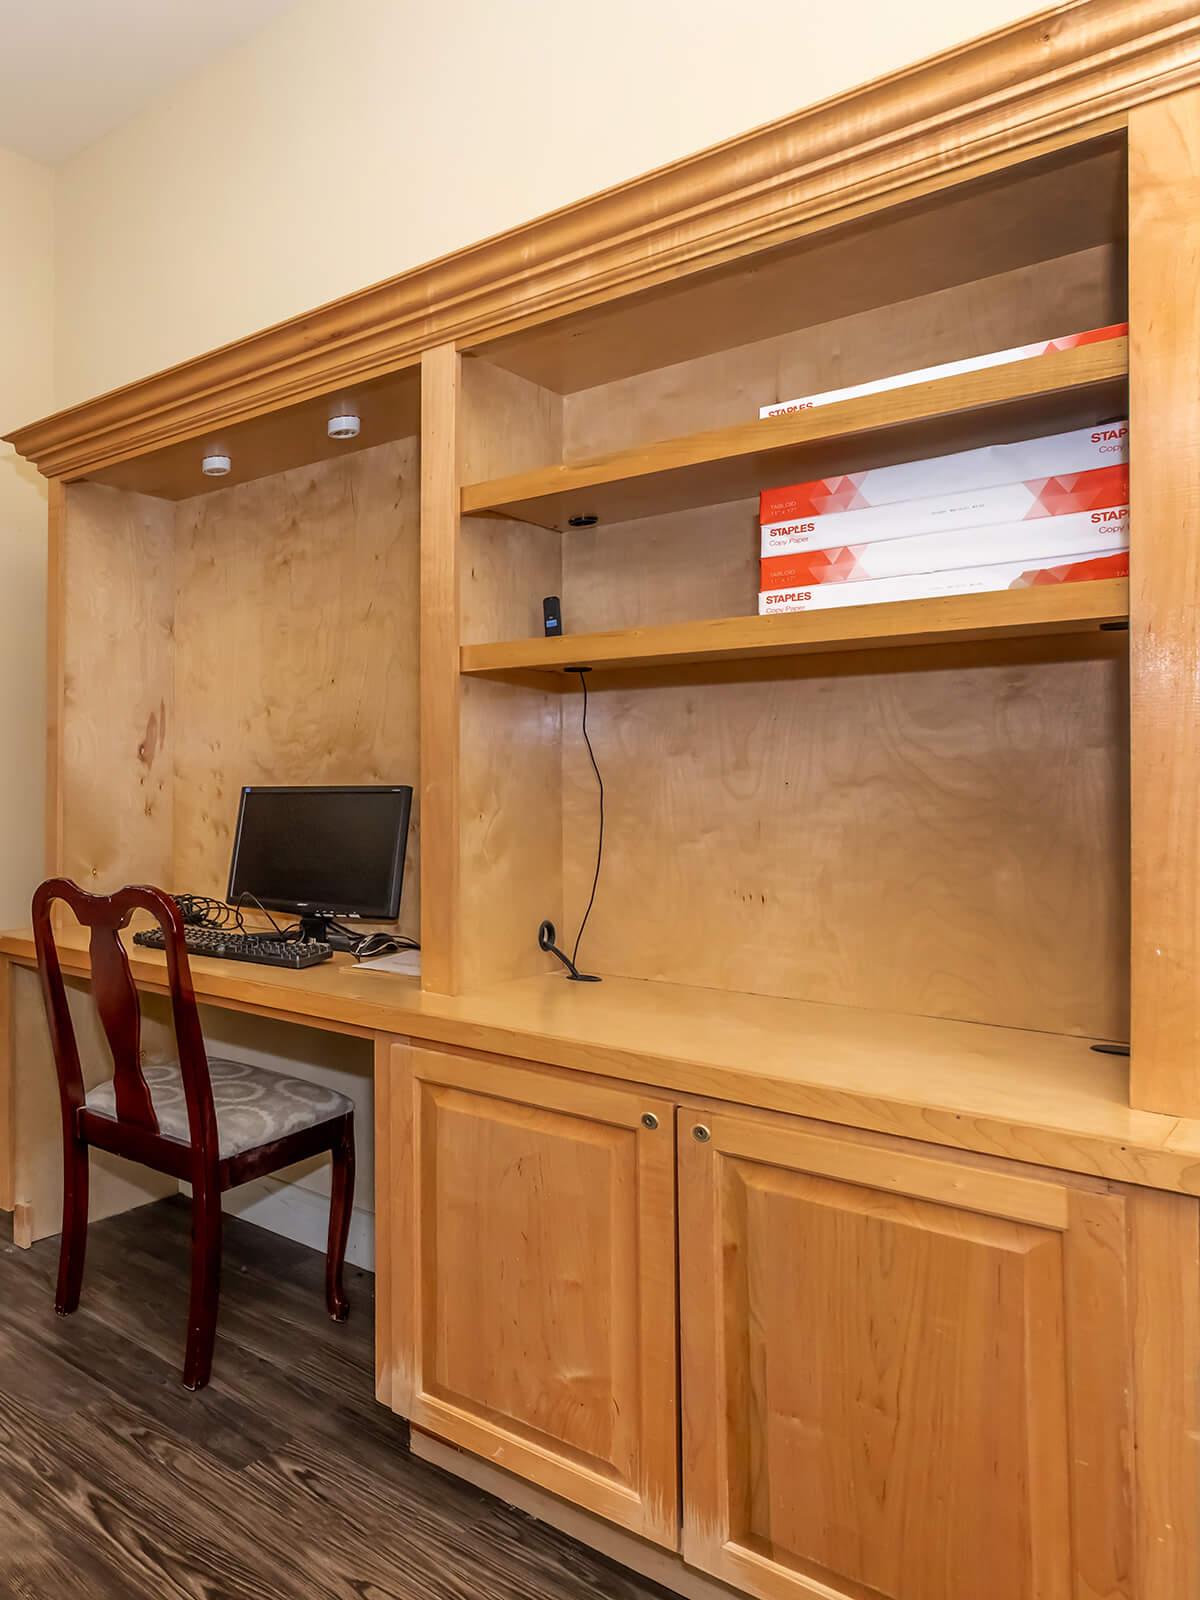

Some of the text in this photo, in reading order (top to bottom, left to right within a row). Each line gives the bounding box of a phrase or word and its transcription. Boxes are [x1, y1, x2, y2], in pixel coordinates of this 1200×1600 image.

[770, 523, 815, 537] STAPLES
[1099, 526, 1125, 536] Copy
[769, 539, 787, 547] Copy
[766, 591, 812, 605] STAPLES
